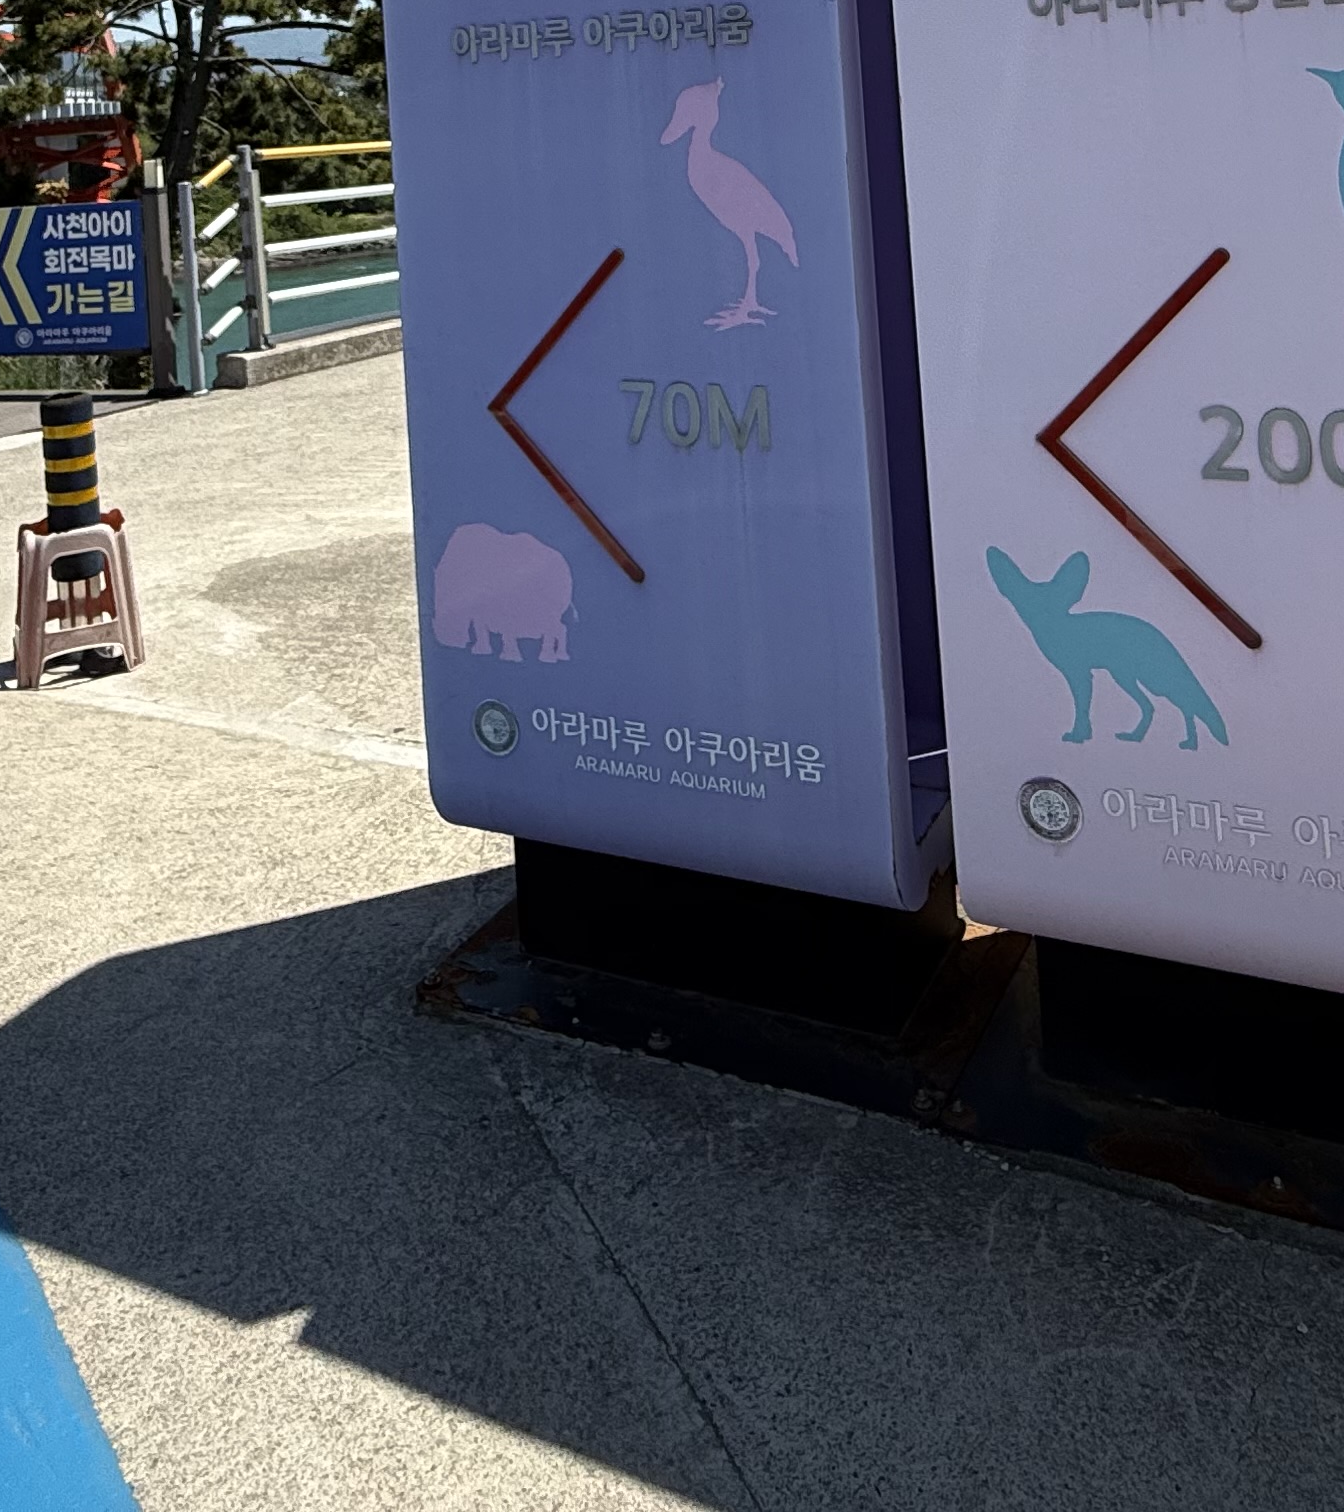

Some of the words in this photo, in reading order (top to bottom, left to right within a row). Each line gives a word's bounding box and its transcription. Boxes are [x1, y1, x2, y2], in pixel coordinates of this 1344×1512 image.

[455, 18, 574, 63] 아라마루
[583, 3, 752, 54] 아쿠아리움
[42, 209, 133, 240] 사천아이
[43, 243, 136, 274] 회전목마
[46, 280, 136, 315] 가는길
[619, 378, 772, 452] 70M
[531, 707, 652, 755] 아라마루
[665, 727, 826, 783] 아쿠아리움
[575, 754, 662, 784] ARAMARU
[669, 772, 766, 800] AQUARIUM
[1102, 788, 1271, 846] 아라마루
[1163, 846, 1288, 882] ARAMARU
